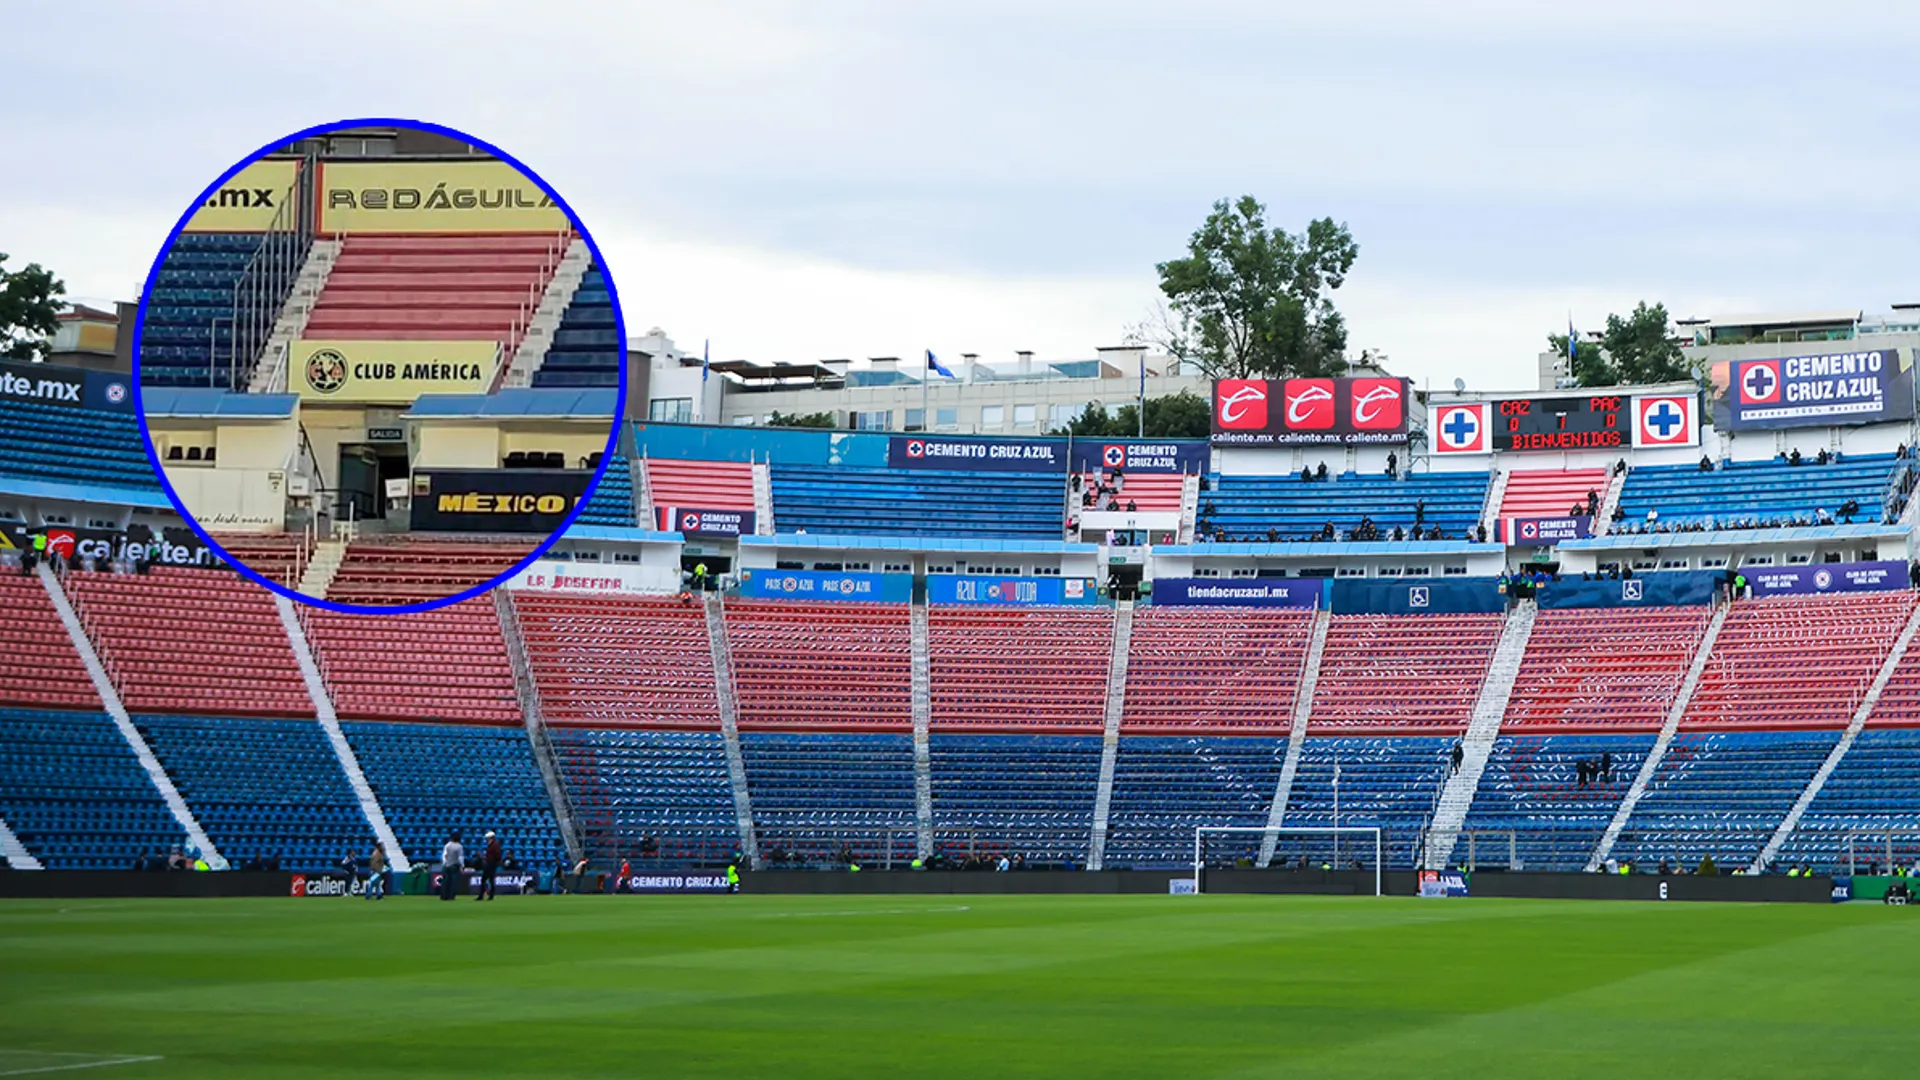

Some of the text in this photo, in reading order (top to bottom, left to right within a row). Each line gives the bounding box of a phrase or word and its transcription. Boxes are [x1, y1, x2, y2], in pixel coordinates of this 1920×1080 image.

[201, 188, 274, 208] .mx
[354, 358, 481, 380] CLUB AMÉRICA
[1785, 352, 1882, 378] CEMENTO
[0, 370, 82, 402] te.mx
[1786, 376, 1883, 402] CRUZ AZUL
[1500, 396, 1621, 416] CAZ PAC
[370, 429, 401, 438] SALIDA
[1211, 432, 1274, 443] caliente.mx
[1278, 432, 1341, 443] caliente.mx
[1345, 431, 1408, 443] caliente.mx
[1511, 431, 1621, 450] BIENVENIDOS
[924, 443, 1054, 460] CEMENTO CRUZ AZUL
[1127, 444, 1177, 456] CEMENTO
[1127, 456, 1177, 468] CRUZ AZUL
[437, 491, 566, 514] MÉXICO
[701, 513, 741, 523] CEMENTO
[1538, 519, 1577, 529] CEMENTO
[701, 522, 721, 531] CRUZ
[1538, 529, 1558, 538] CRUZ
[1187, 585, 1289, 599] tiendacruzazul.mx
[631, 876, 683, 888] CEMENTO
[685, 876, 712, 888] CRUZ
